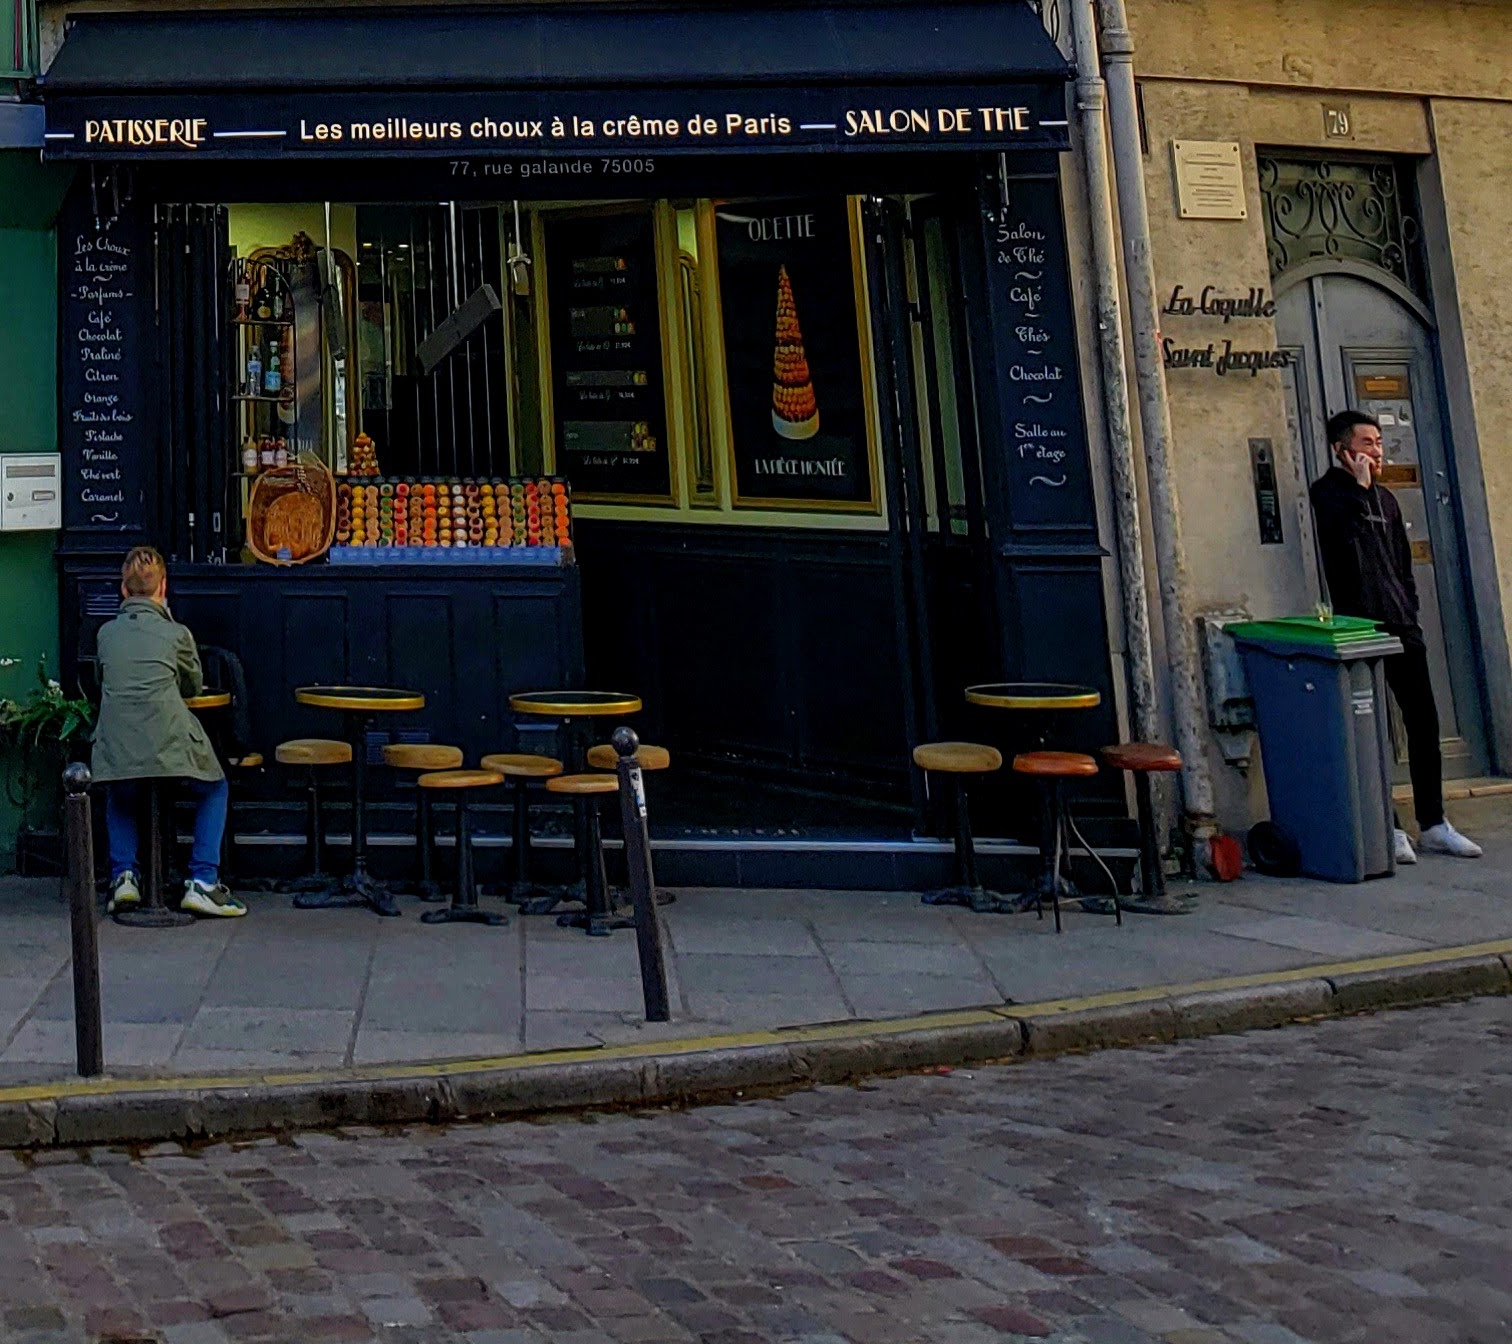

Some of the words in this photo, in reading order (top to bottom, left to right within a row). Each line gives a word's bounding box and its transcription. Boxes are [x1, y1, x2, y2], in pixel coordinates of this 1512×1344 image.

[300, 119, 342, 140] Les
[350, 118, 461, 140] meilleurs
[470, 116, 544, 139] choux
[550, 115, 565, 138] à
[573, 115, 594, 137] la
[687, 114, 717, 136] de
[725, 113, 791, 135] Paris
[844, 108, 931, 136] SALON
[938, 108, 972, 132] DE
[978, 107, 1030, 131] THE
[1328, 110, 1349, 135] 79
[85, 118, 208, 148] PATISSERIE
[450, 161, 477, 177] 77,
[484, 162, 513, 176] rue
[520, 159, 593, 178] galande
[600, 159, 655, 174] 75005
[748, 214, 815, 241] ODETTE
[997, 222, 1045, 242] Salon
[75, 234, 93, 255] Les
[96, 236, 130, 255] Choux
[86, 256, 97, 271] la
[998, 251, 1011, 263] de
[1013, 246, 1045, 263] Thé
[79, 285, 123, 306] Parfums
[1010, 286, 1041, 310] Café
[1163, 285, 1194, 316] La
[1199, 285, 1277, 324] Coquille
[88, 310, 112, 329] Café
[78, 328, 122, 341] Chocolat
[81, 346, 121, 361] Praliné
[1163, 337, 1215, 369] Saint
[1216, 339, 1292, 377] Jacques
[85, 368, 119, 382] Citron
[1010, 365, 1062, 381] Chocolat
[84, 392, 118, 406] Orange
[85, 429, 123, 442] Pistache
[1015, 423, 1048, 438] Salle
[1050, 427, 1067, 437] au
[83, 448, 118, 461] Vanille
[81, 488, 124, 502] Caramel
